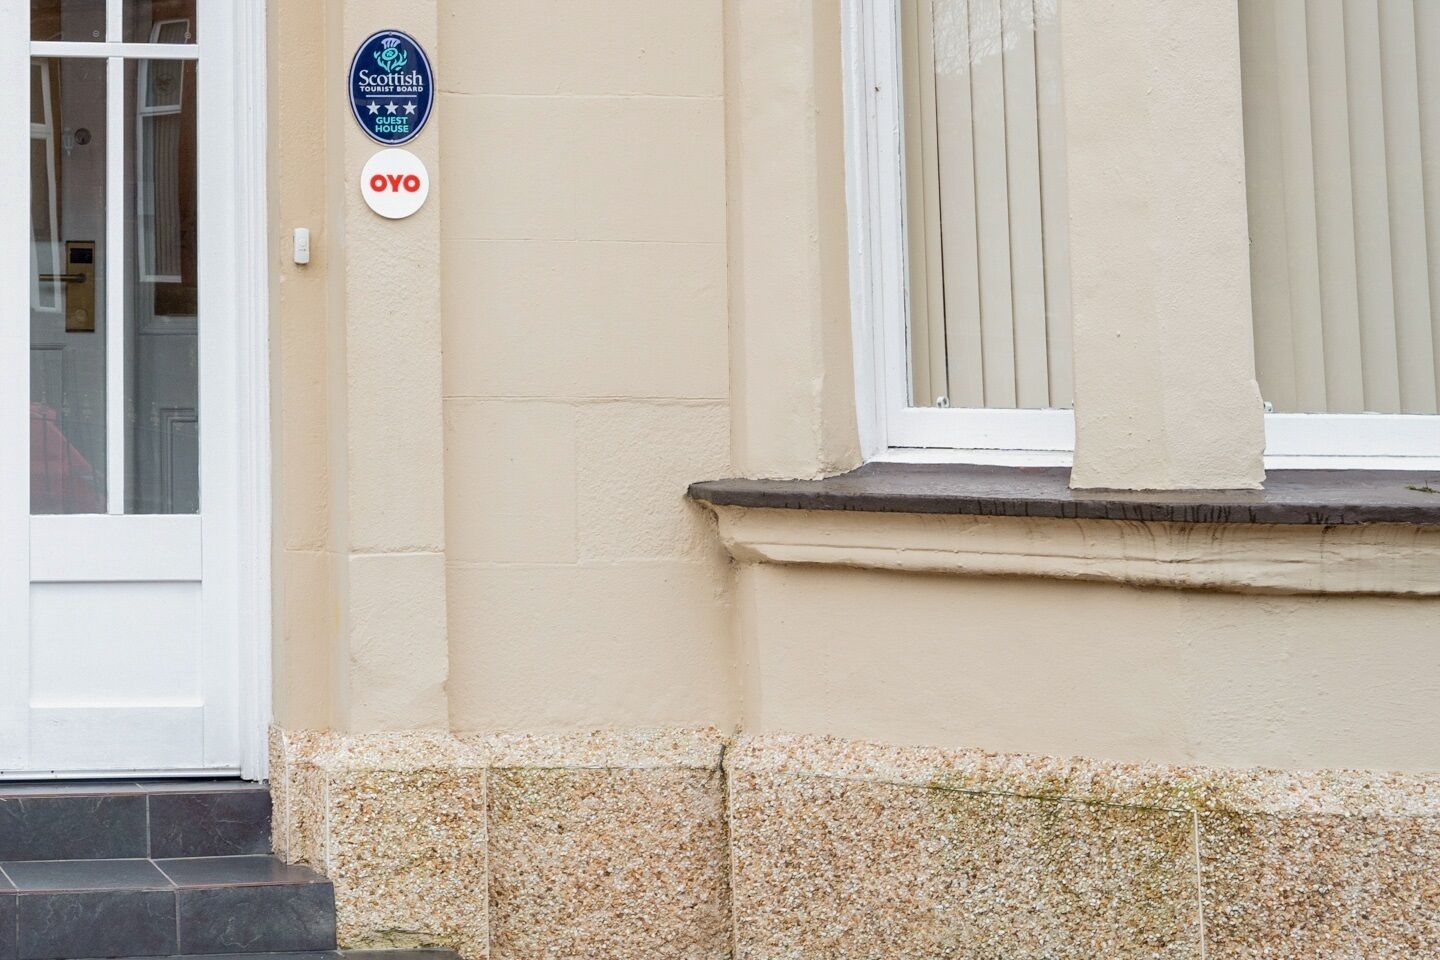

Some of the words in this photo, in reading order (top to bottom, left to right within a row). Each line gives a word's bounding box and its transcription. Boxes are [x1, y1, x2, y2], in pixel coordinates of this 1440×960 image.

[358, 69, 424, 86] Scottish
[375, 116, 408, 125] GUEST
[375, 125, 409, 133] HOUSE
[369, 174, 421, 193] OYO
